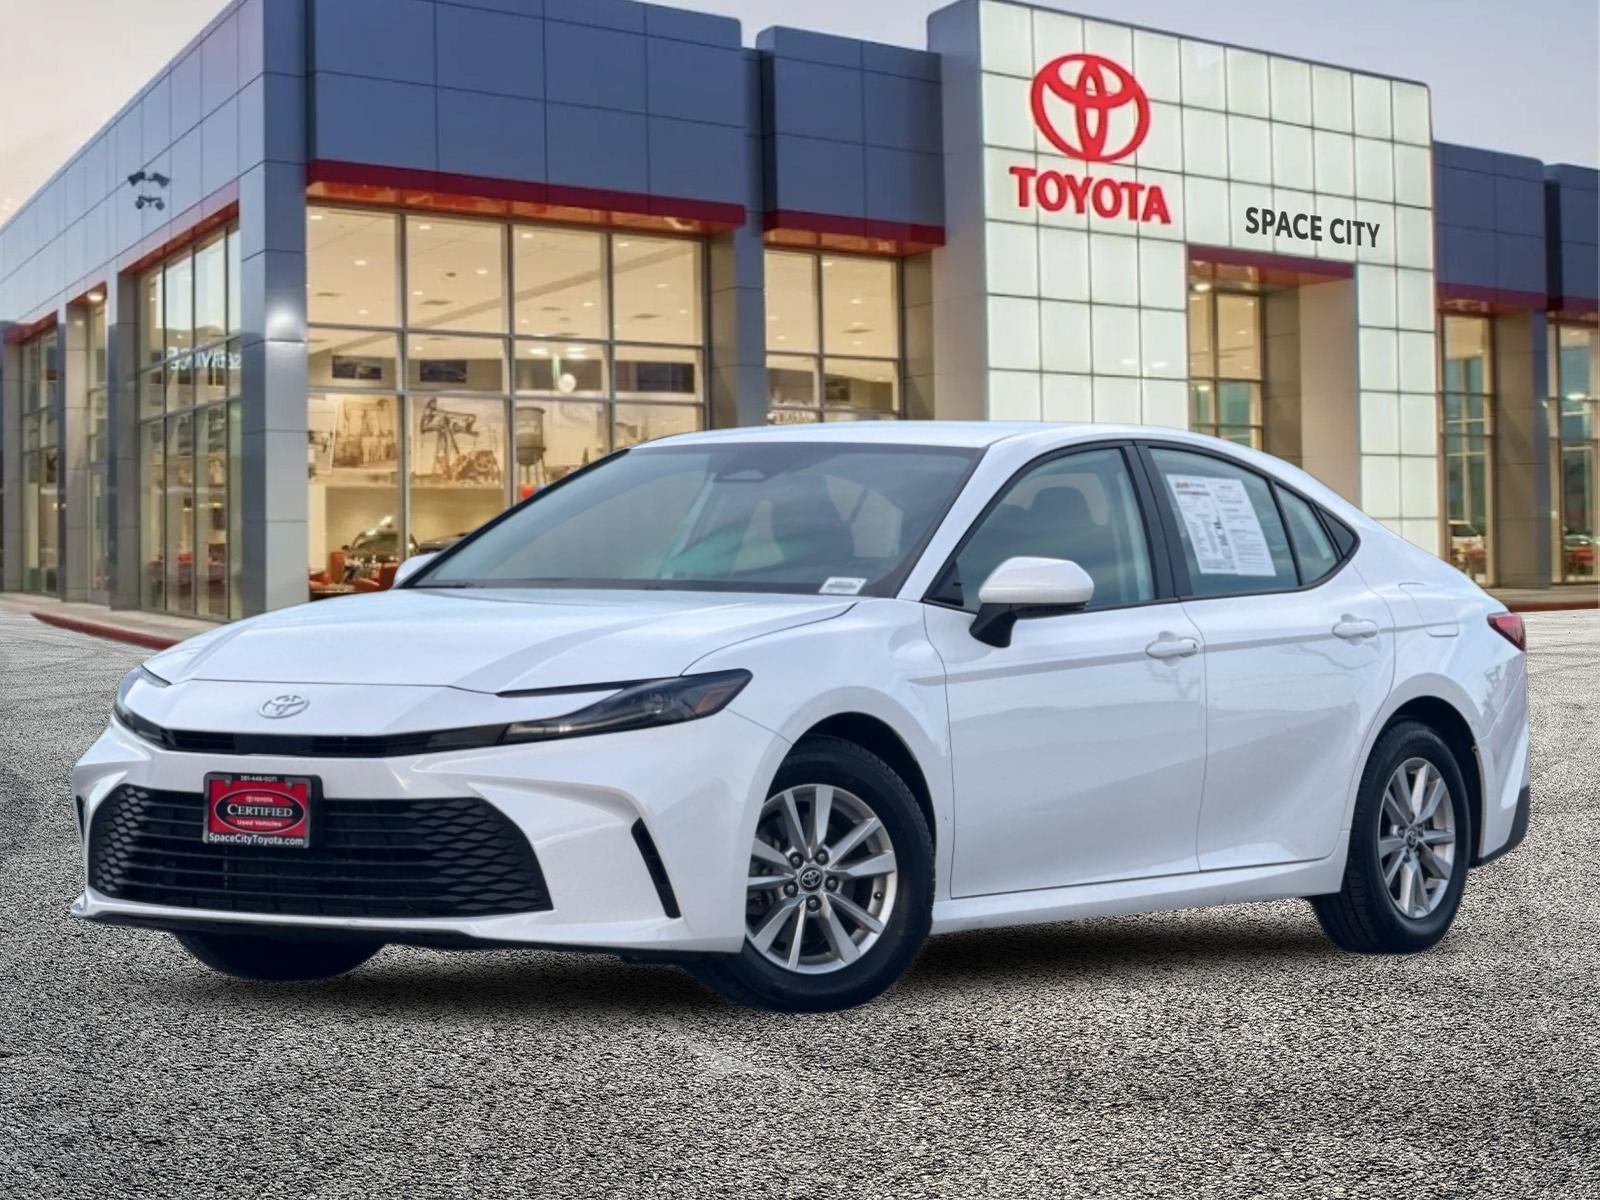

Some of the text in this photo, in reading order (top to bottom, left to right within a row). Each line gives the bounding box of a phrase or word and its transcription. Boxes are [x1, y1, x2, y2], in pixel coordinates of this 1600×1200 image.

[1009, 166, 1171, 224] TOYOTA
[1245, 206, 1381, 248] SPACE CITY
[255, 819, 283, 827] Vehicles
[209, 833, 304, 846] SpaceCityToyota.com
